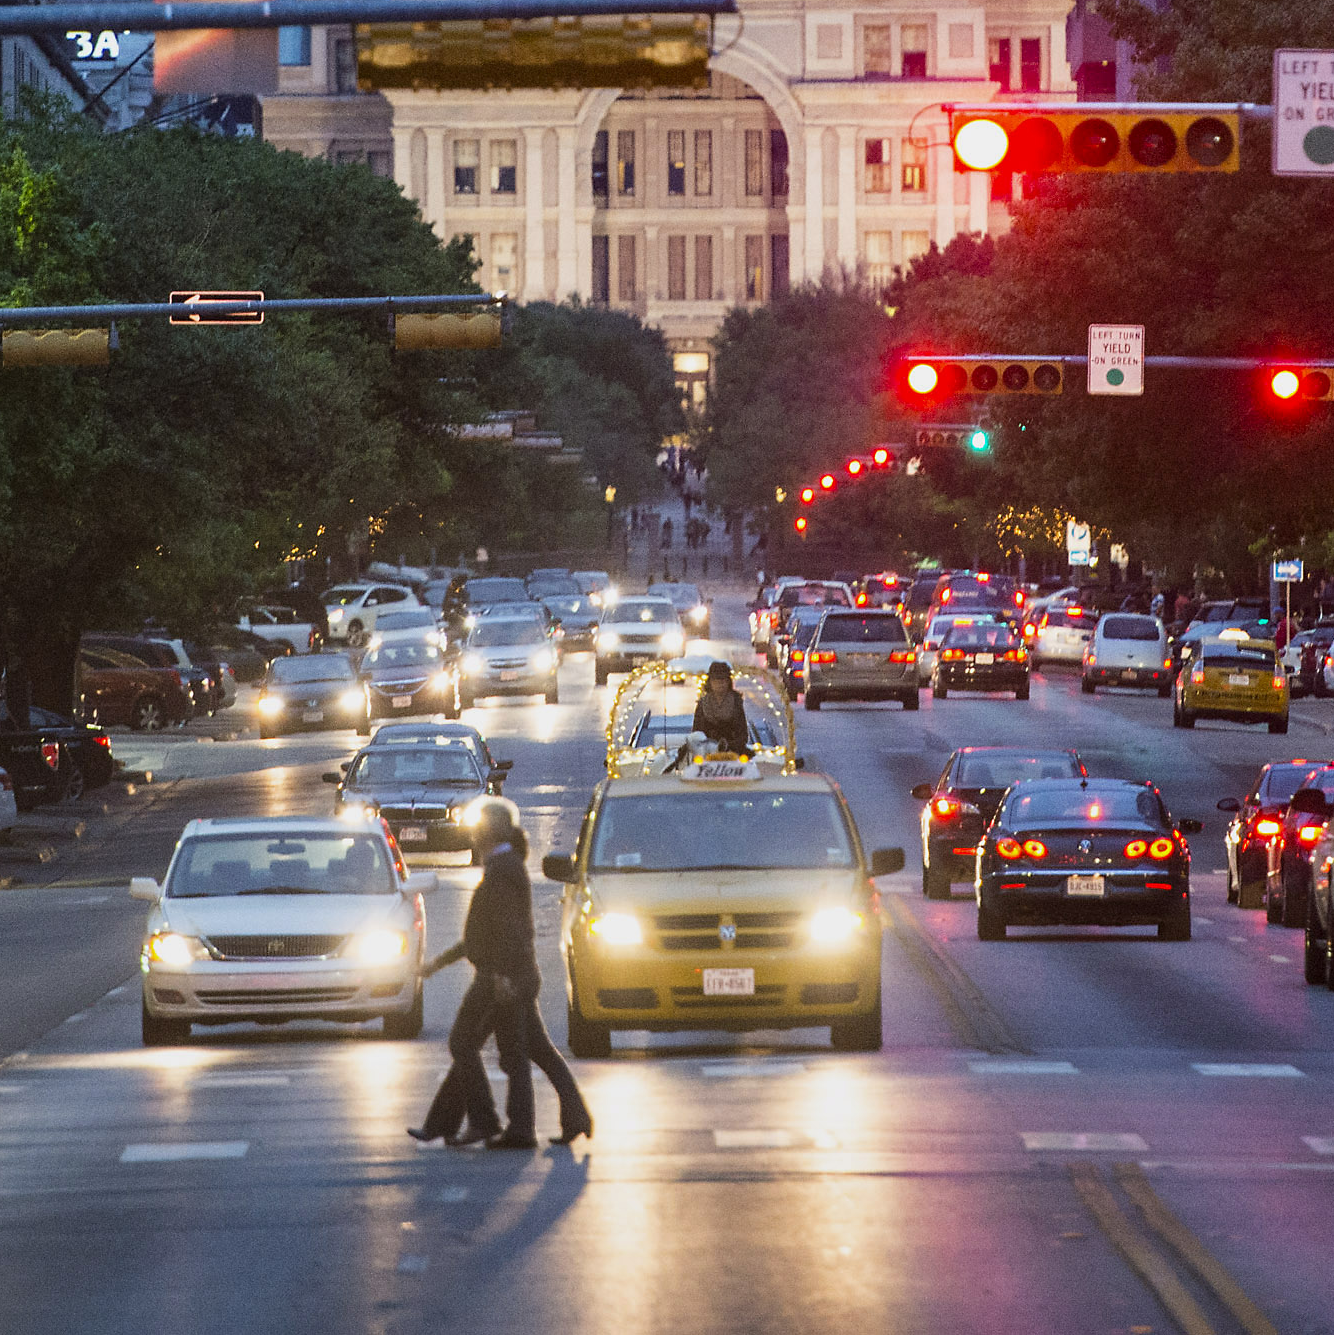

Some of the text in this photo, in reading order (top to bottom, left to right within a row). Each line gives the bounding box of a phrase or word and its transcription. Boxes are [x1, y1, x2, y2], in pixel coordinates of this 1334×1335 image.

[1281, 60, 1318, 75] LEFT
[1284, 106, 1305, 121] ON
[1092, 330, 1141, 341] LEFT TURN
[1102, 343, 1131, 354] YIELD
[1094, 356, 1139, 366] ON GREEN
[696, 763, 745, 778] Yellow
